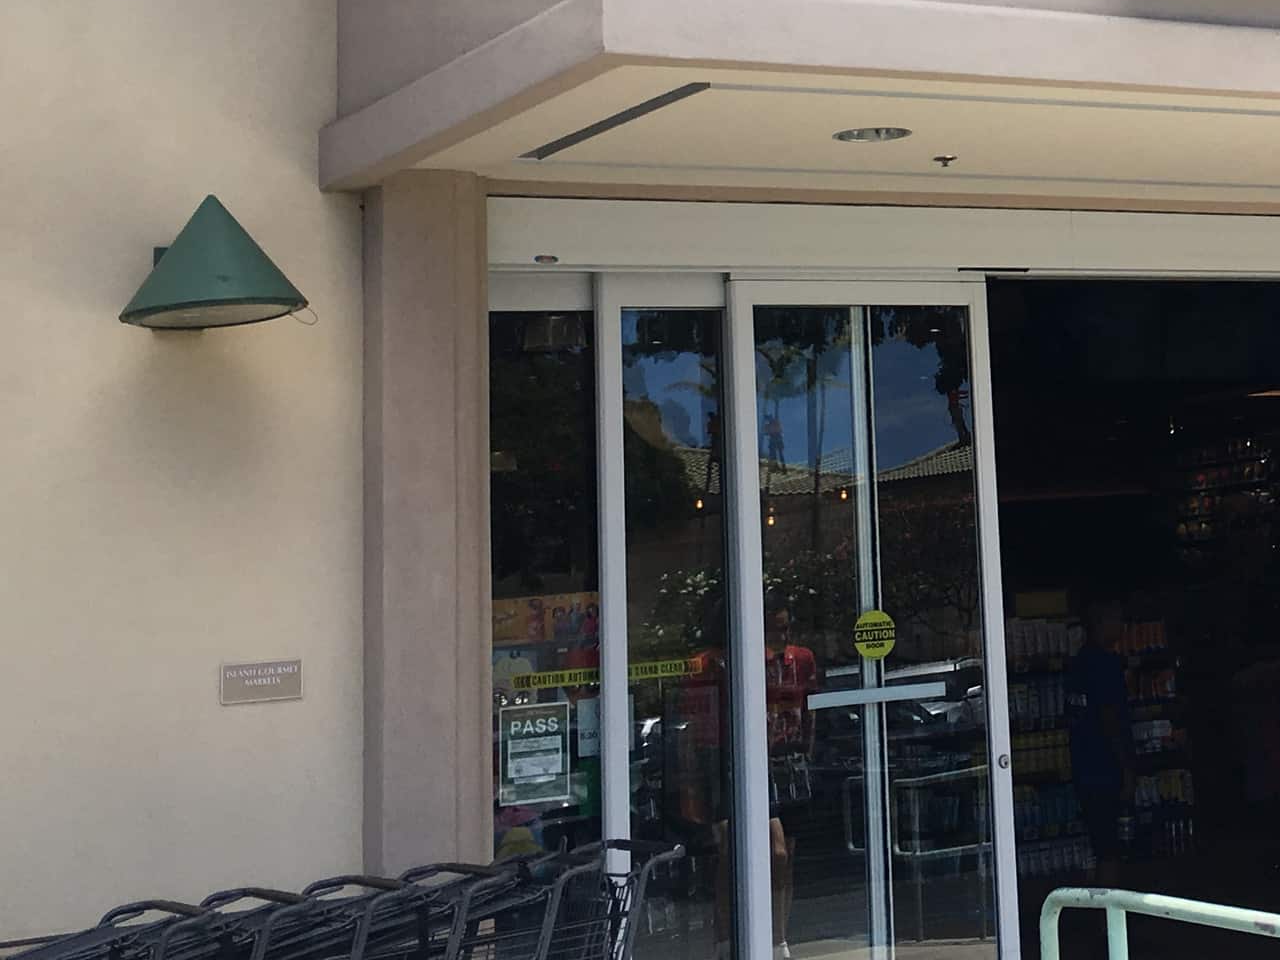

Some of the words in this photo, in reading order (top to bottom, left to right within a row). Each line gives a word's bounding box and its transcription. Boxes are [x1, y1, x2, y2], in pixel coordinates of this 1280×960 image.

[855, 629, 895, 641] CAUTION
[532, 672, 565, 686] CAUTION
[510, 717, 559, 735] PASS
